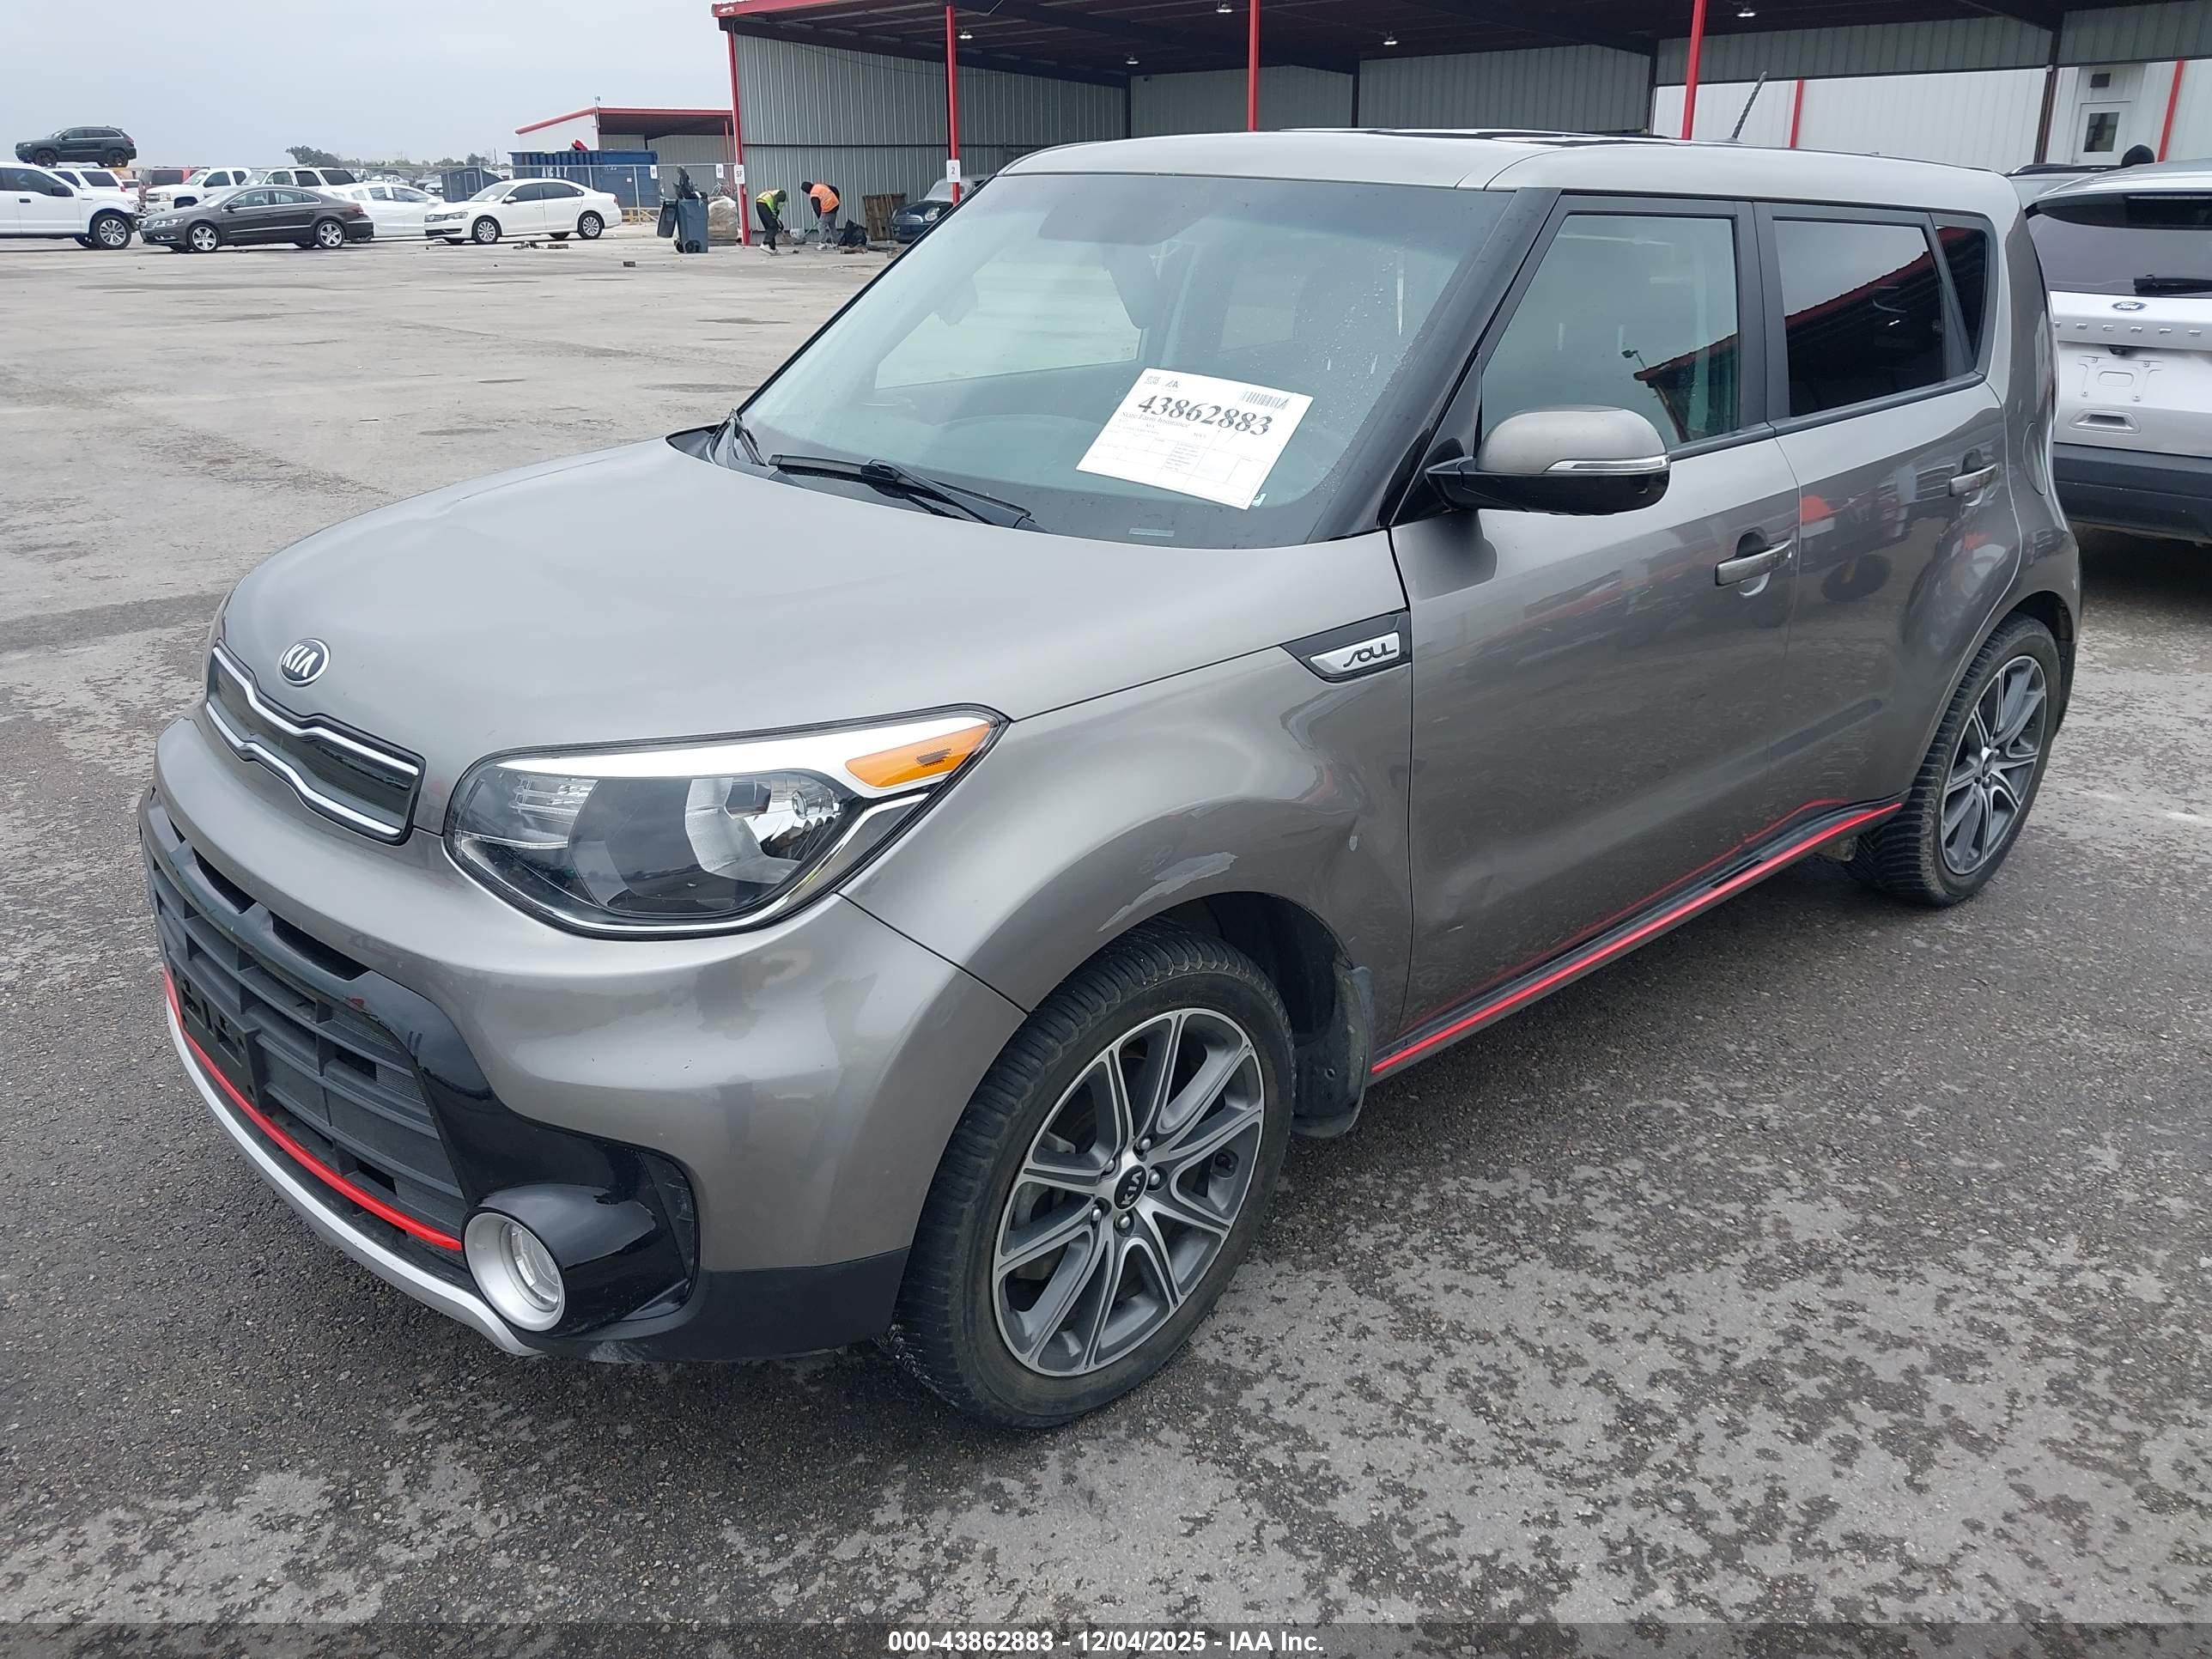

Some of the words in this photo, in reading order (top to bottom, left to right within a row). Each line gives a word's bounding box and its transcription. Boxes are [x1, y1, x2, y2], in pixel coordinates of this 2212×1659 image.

[1121, 411, 1139, 421] State
[1139, 413, 1157, 423] Farm
[1138, 394, 1273, 436] 43862883
[282, 643, 319, 678] KIA
[1342, 642, 1397, 668] SOUL
[1120, 1170, 1143, 1205] KIA
